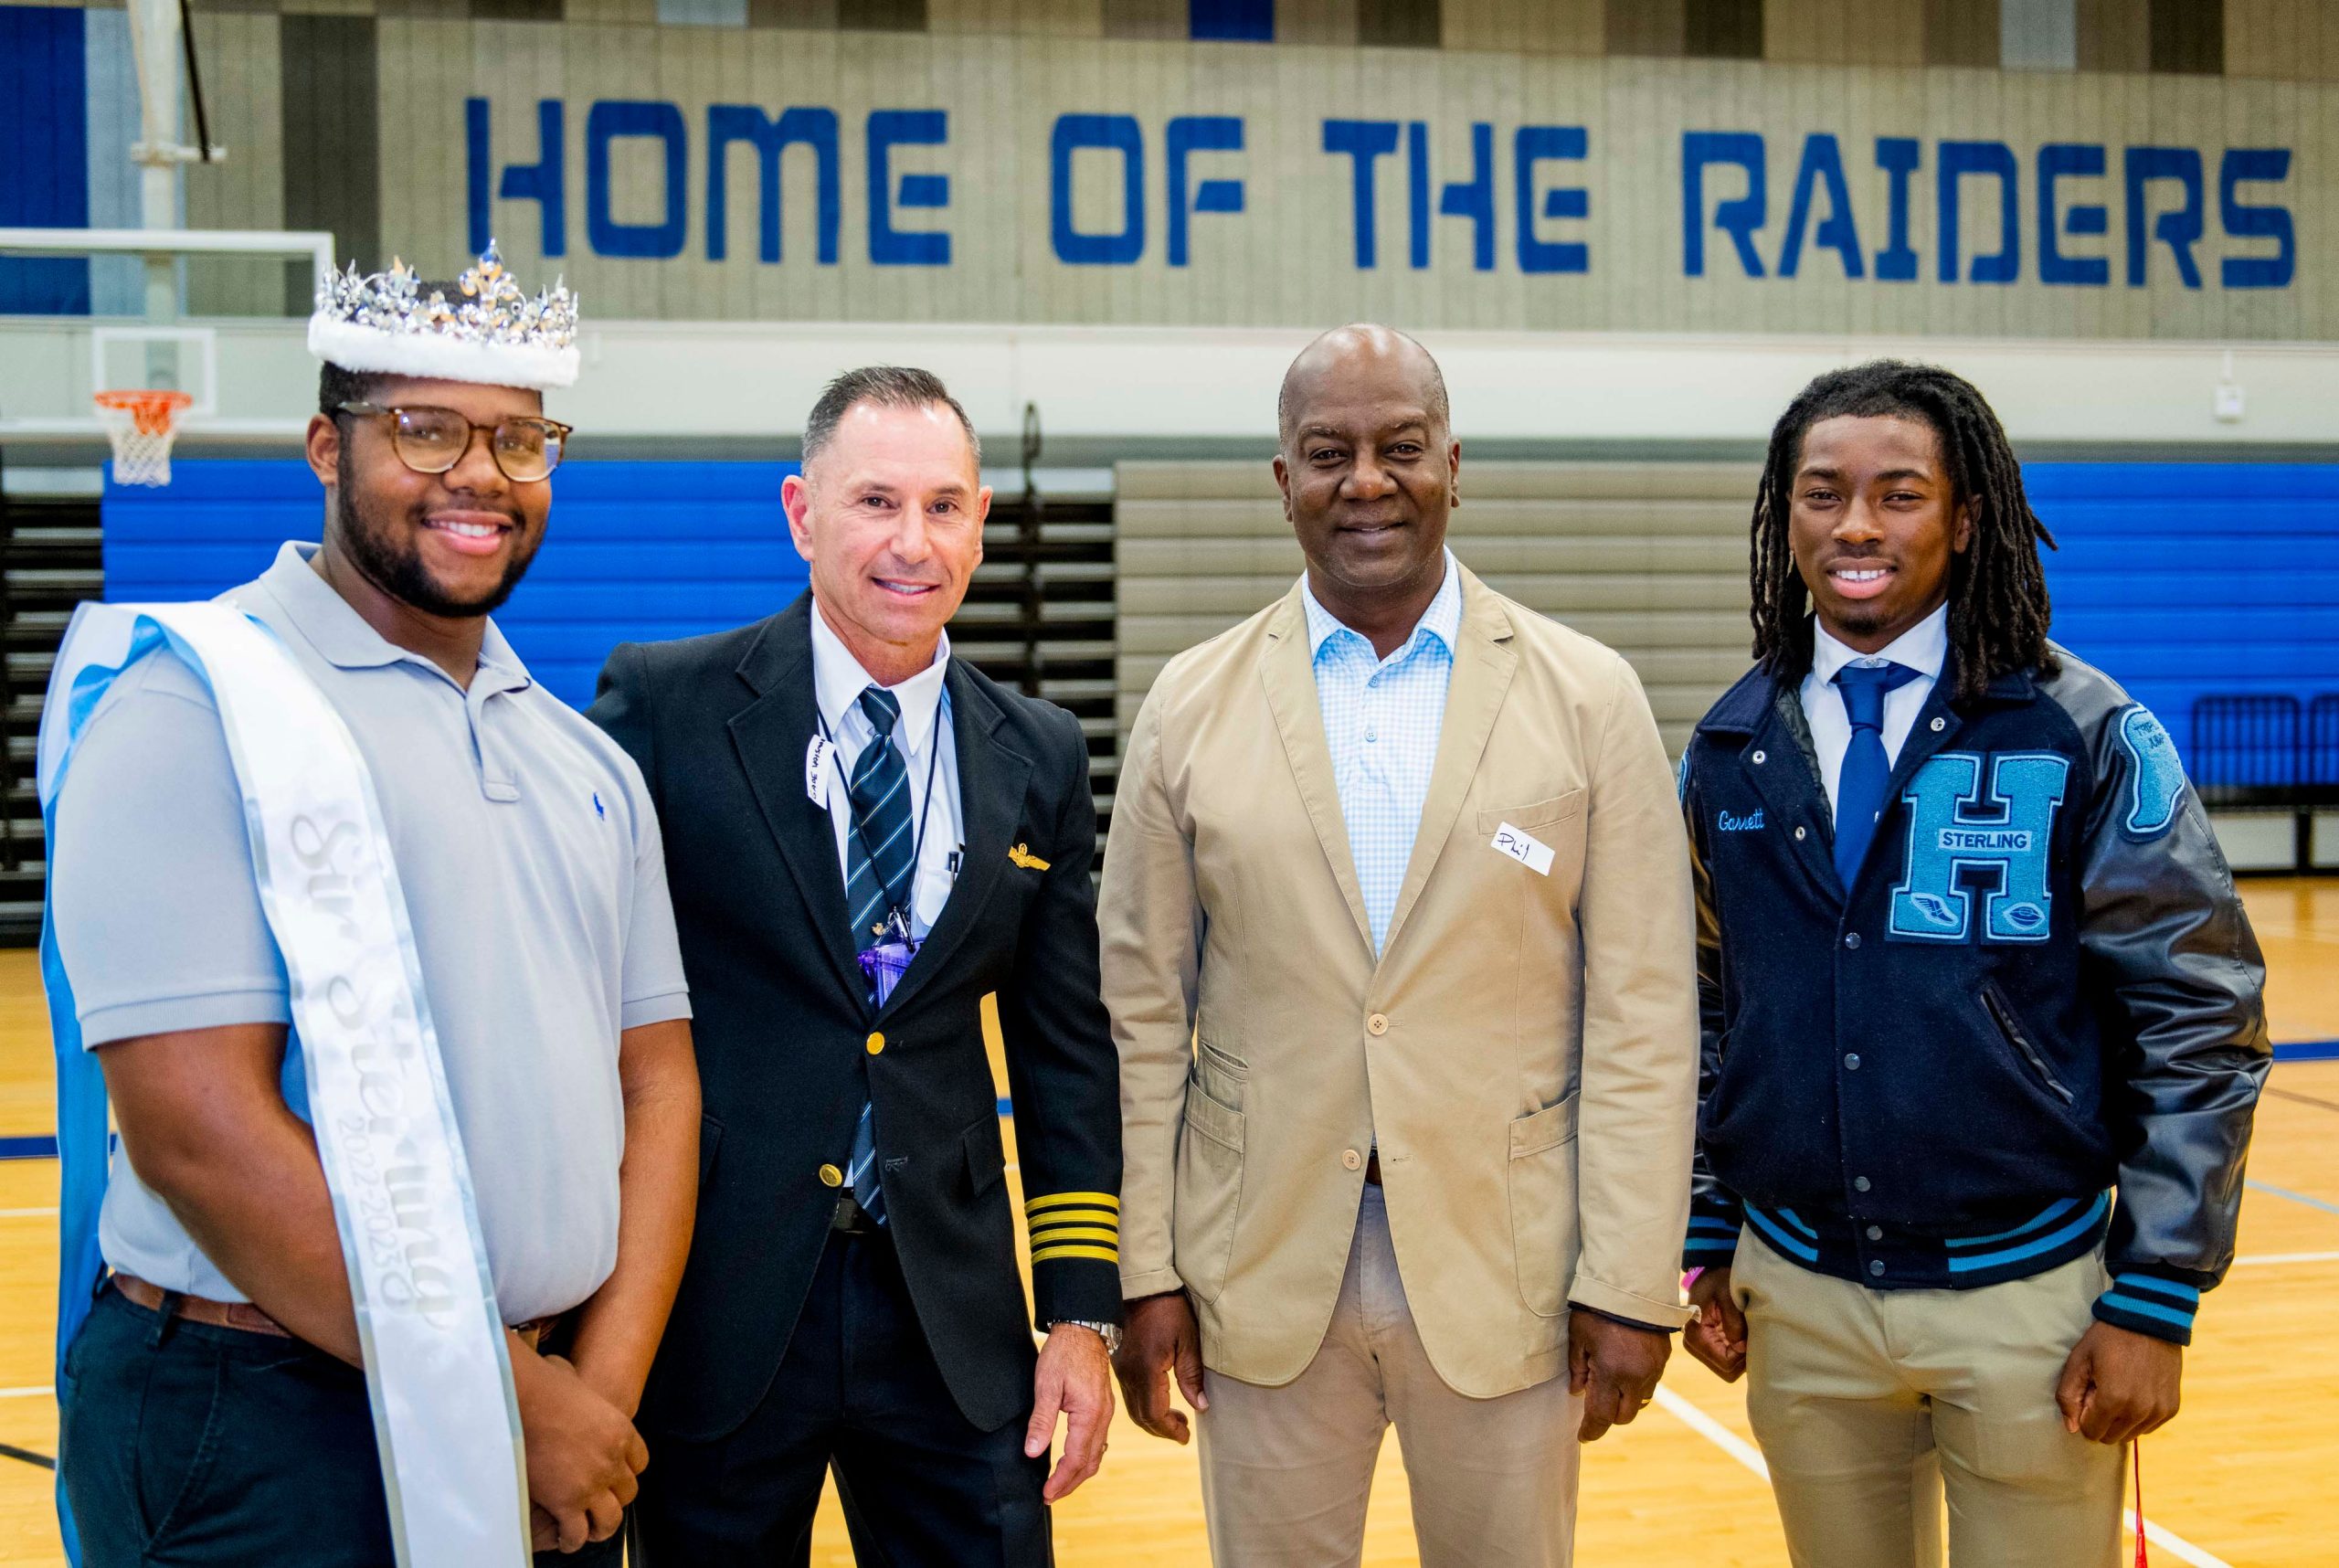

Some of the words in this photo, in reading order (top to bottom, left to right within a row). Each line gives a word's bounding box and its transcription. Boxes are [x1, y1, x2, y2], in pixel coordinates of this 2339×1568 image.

[465, 97, 952, 267] HOME
[1050, 112, 1246, 268] OF
[1321, 119, 1590, 273] THE
[1681, 131, 2297, 291] RAIDERS
[290, 813, 367, 942] Sir
[1498, 832, 1530, 861] Phil
[1719, 808, 1764, 831] Garrett
[1889, 754, 2069, 940] H
[1942, 832, 2027, 849] STERLING
[326, 974, 460, 1330] Sterling
[336, 1116, 403, 1269] 2022-2023
